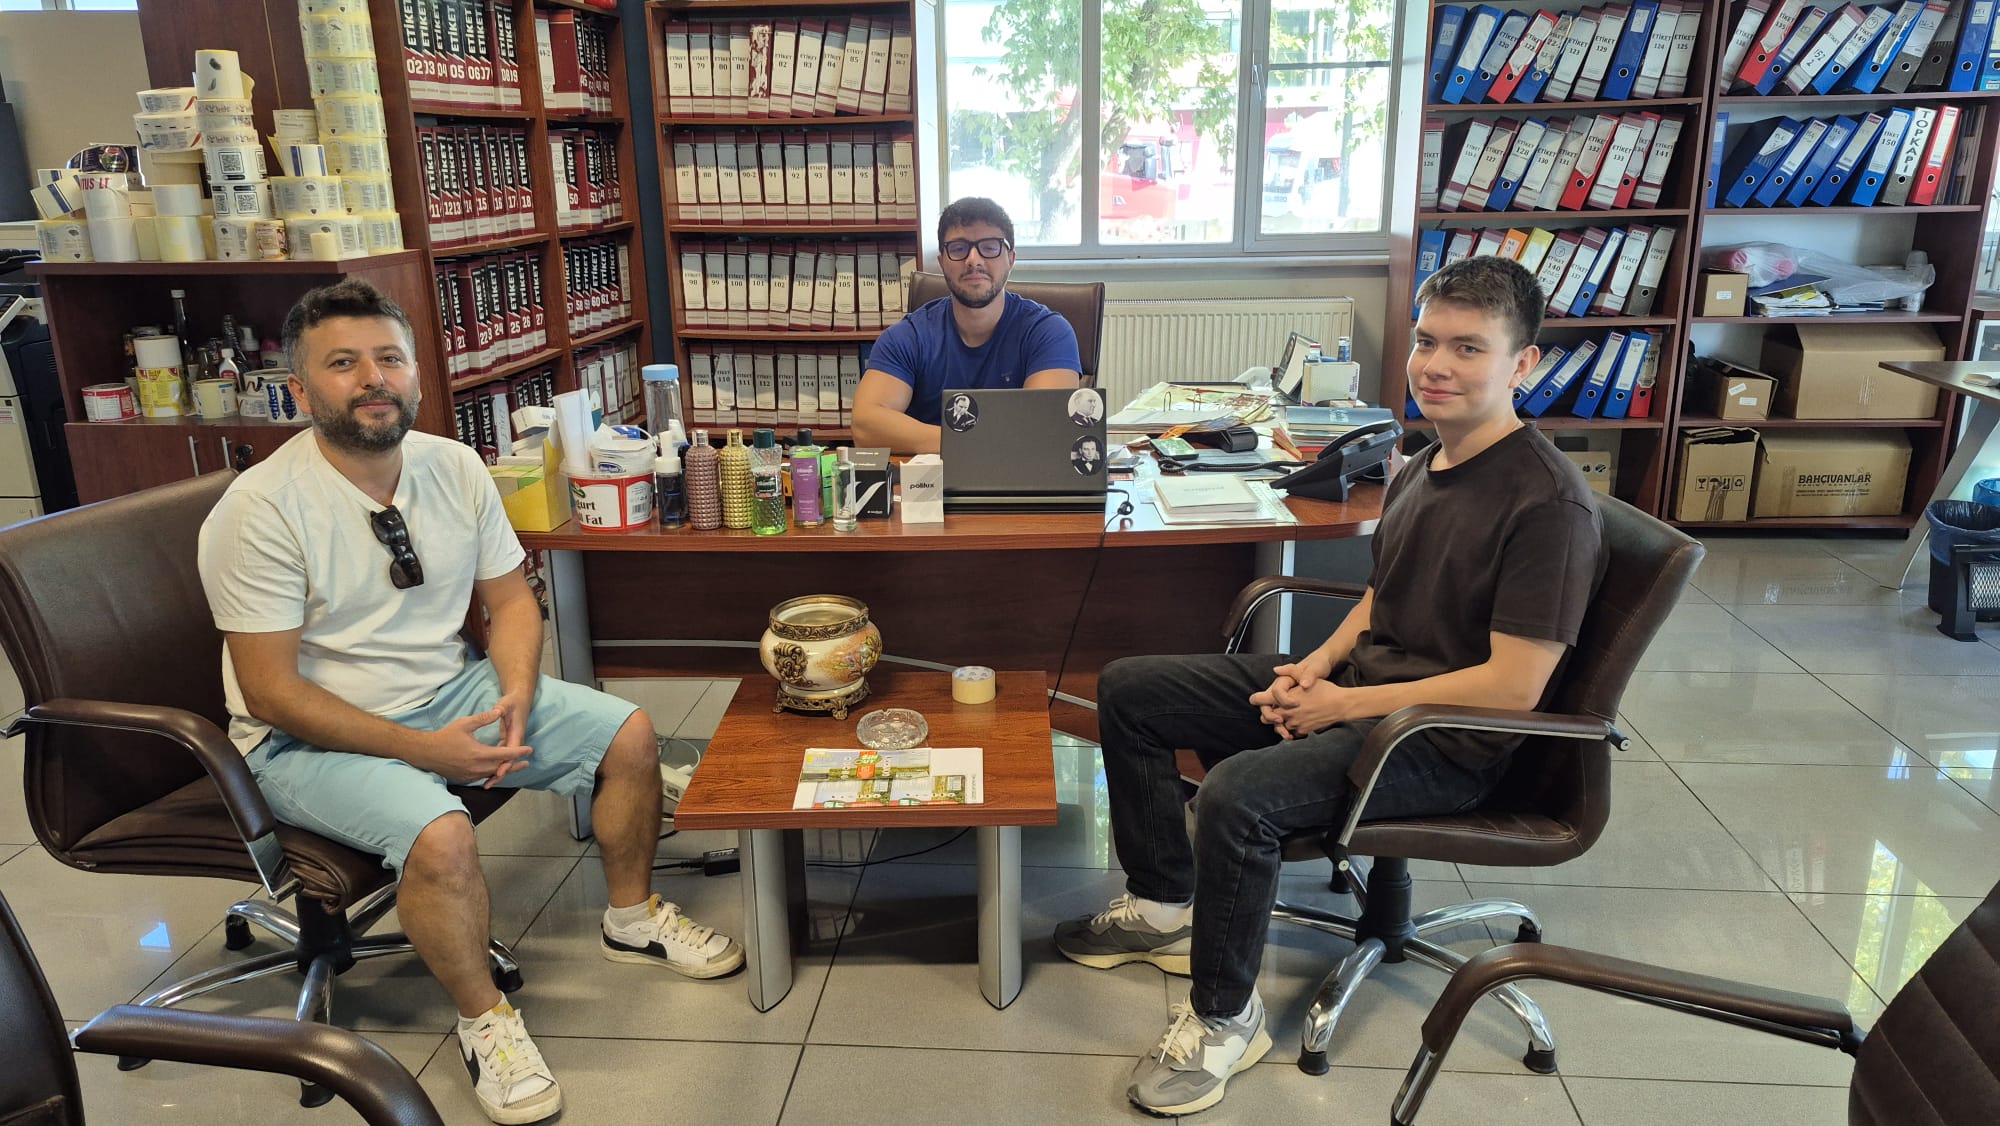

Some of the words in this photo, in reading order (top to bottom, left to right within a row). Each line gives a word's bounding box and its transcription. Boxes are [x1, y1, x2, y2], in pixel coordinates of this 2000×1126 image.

[447, 5, 460, 52] ETİKET
[465, 8, 476, 54] ETİKET
[475, 8, 486, 54] ETİKET
[1853, 32, 1867, 44] 149
[407, 59, 423, 74] 02
[450, 64, 465, 79] 05
[468, 66, 480, 80] 06
[1881, 138, 1896, 147] 150
[1903, 110, 1932, 173] TOPKAPI
[425, 143, 436, 191] ETİKET
[473, 142, 484, 186] ETİKET
[517, 143, 528, 185] ETİKET
[566, 144, 576, 183] ETİKET
[477, 198, 487, 211] 15
[508, 196, 516, 208] 17
[521, 196, 532, 208] 18
[569, 193, 578, 204] 50
[444, 202, 453, 215] 12
[1547, 263, 1561, 272] 140
[508, 269, 517, 310] ETİKET
[522, 316, 531, 328] 26
[536, 314, 543, 325] 27
[511, 321, 520, 334] 25
[482, 402, 492, 443] ETİKET
[585, 514, 603, 525] Fat
